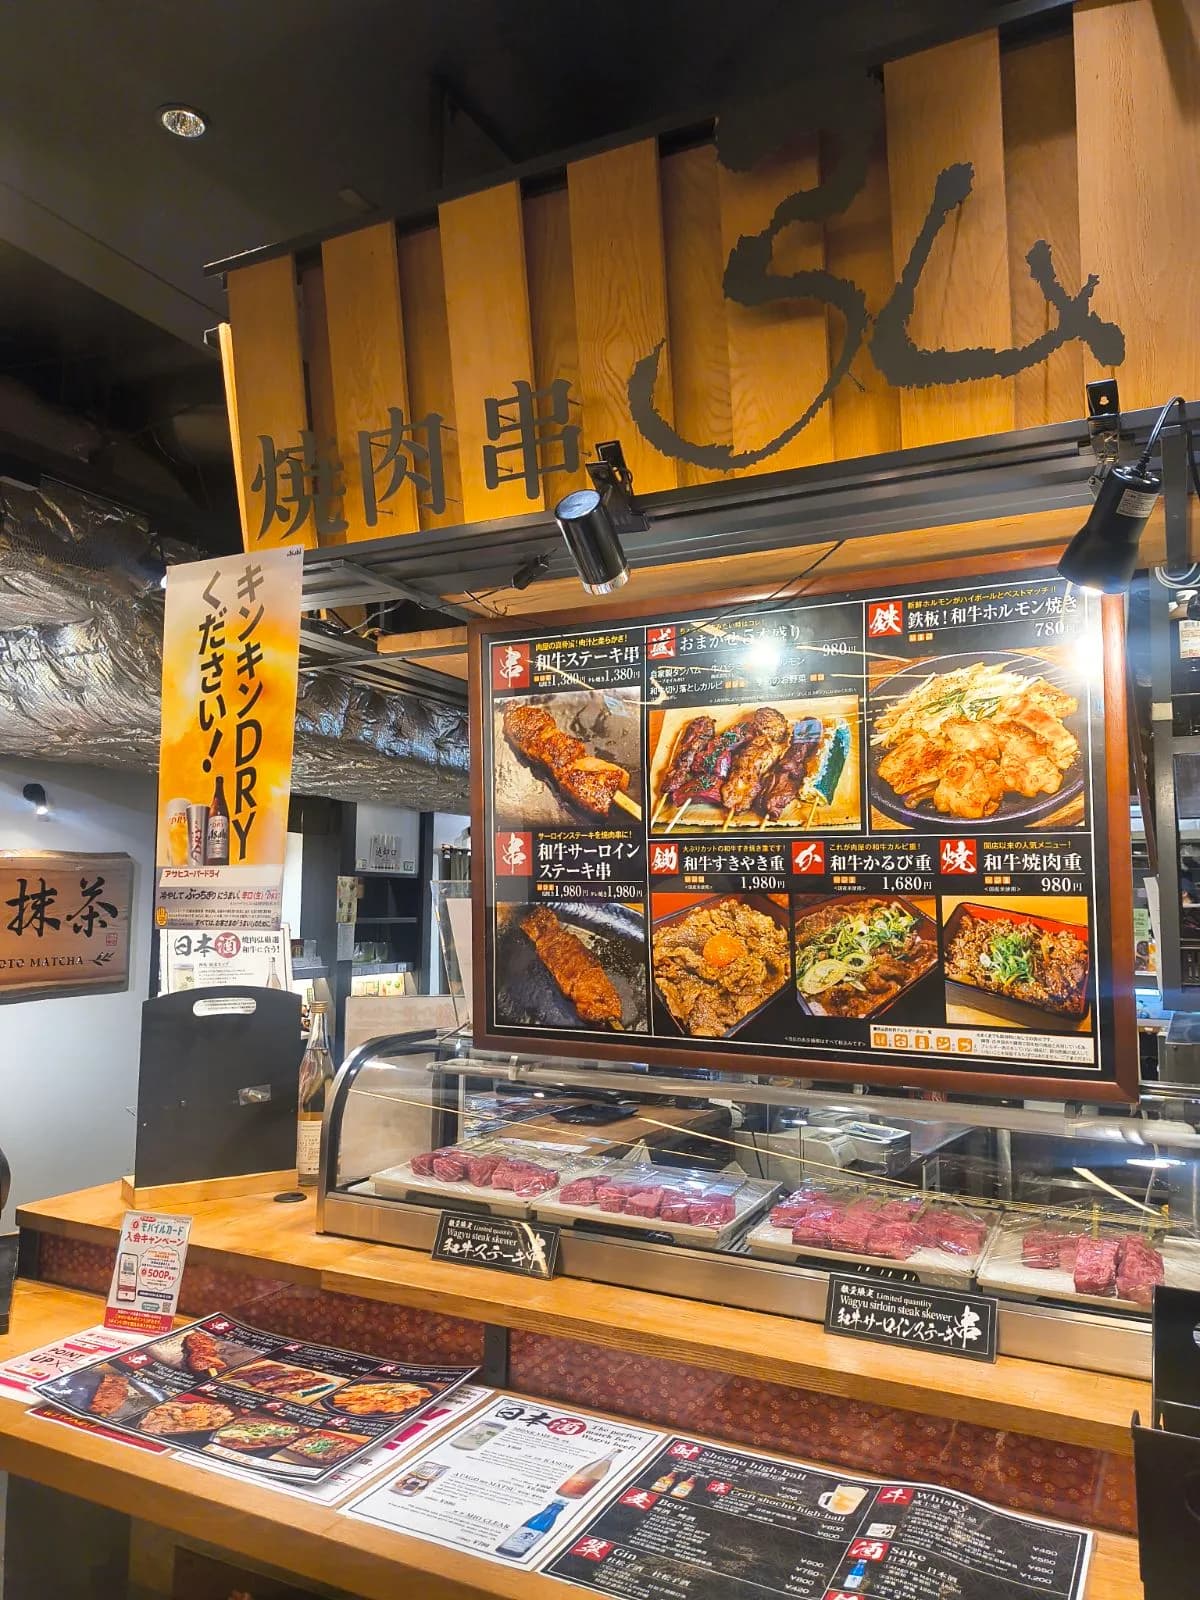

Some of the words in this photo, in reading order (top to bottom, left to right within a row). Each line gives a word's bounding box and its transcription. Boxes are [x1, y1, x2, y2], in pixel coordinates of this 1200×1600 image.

[251, 378, 584, 542] 焼肉串
[198, 570, 227, 773] ください!
[605, 668, 641, 684] 1,380円
[232, 563, 265, 861] キンキンDRY
[537, 842, 641, 862] 和牛サーロイン
[539, 861, 612, 881] ステーキ串
[683, 855, 785, 872] 和牛すきやき重
[830, 854, 932, 872] 和牛かるび重
[983, 853, 1083, 872] 和牛焼肉重
[554, 885, 589, 898] 1,980円
[607, 885, 643, 898] 1,980円
[741, 876, 785, 890] 1,980円
[882, 876, 932, 891] 1,680円
[1041, 877, 1083, 893] 980円
[5, 876, 118, 937] 抹茶
[30, 956, 84, 967] MATCHA
[447, 1228, 471, 1240] Wagyu
[471, 1232, 491, 1242] steak
[491, 1235, 518, 1246] skewer
[840, 1294, 868, 1309] Wagyu
[869, 1301, 896, 1314] sirloin
[897, 1306, 920, 1318] steak
[921, 1310, 952, 1323] skewer
[876, 1293, 903, 1303] Limited
[903, 1297, 933, 1308] quantity
[495, 1406, 587, 1436] 日本酒
[701, 1450, 748, 1467] Shochu
[750, 1461, 807, 1481] high-ball
[657, 1499, 689, 1512] Beer
[730, 1490, 756, 1501] Craft
[758, 1497, 796, 1511] shochu
[796, 1506, 846, 1522] high-ball
[916, 1491, 969, 1512] Whisky
[613, 1548, 637, 1560] Gin
[889, 1546, 927, 1562] Sake
